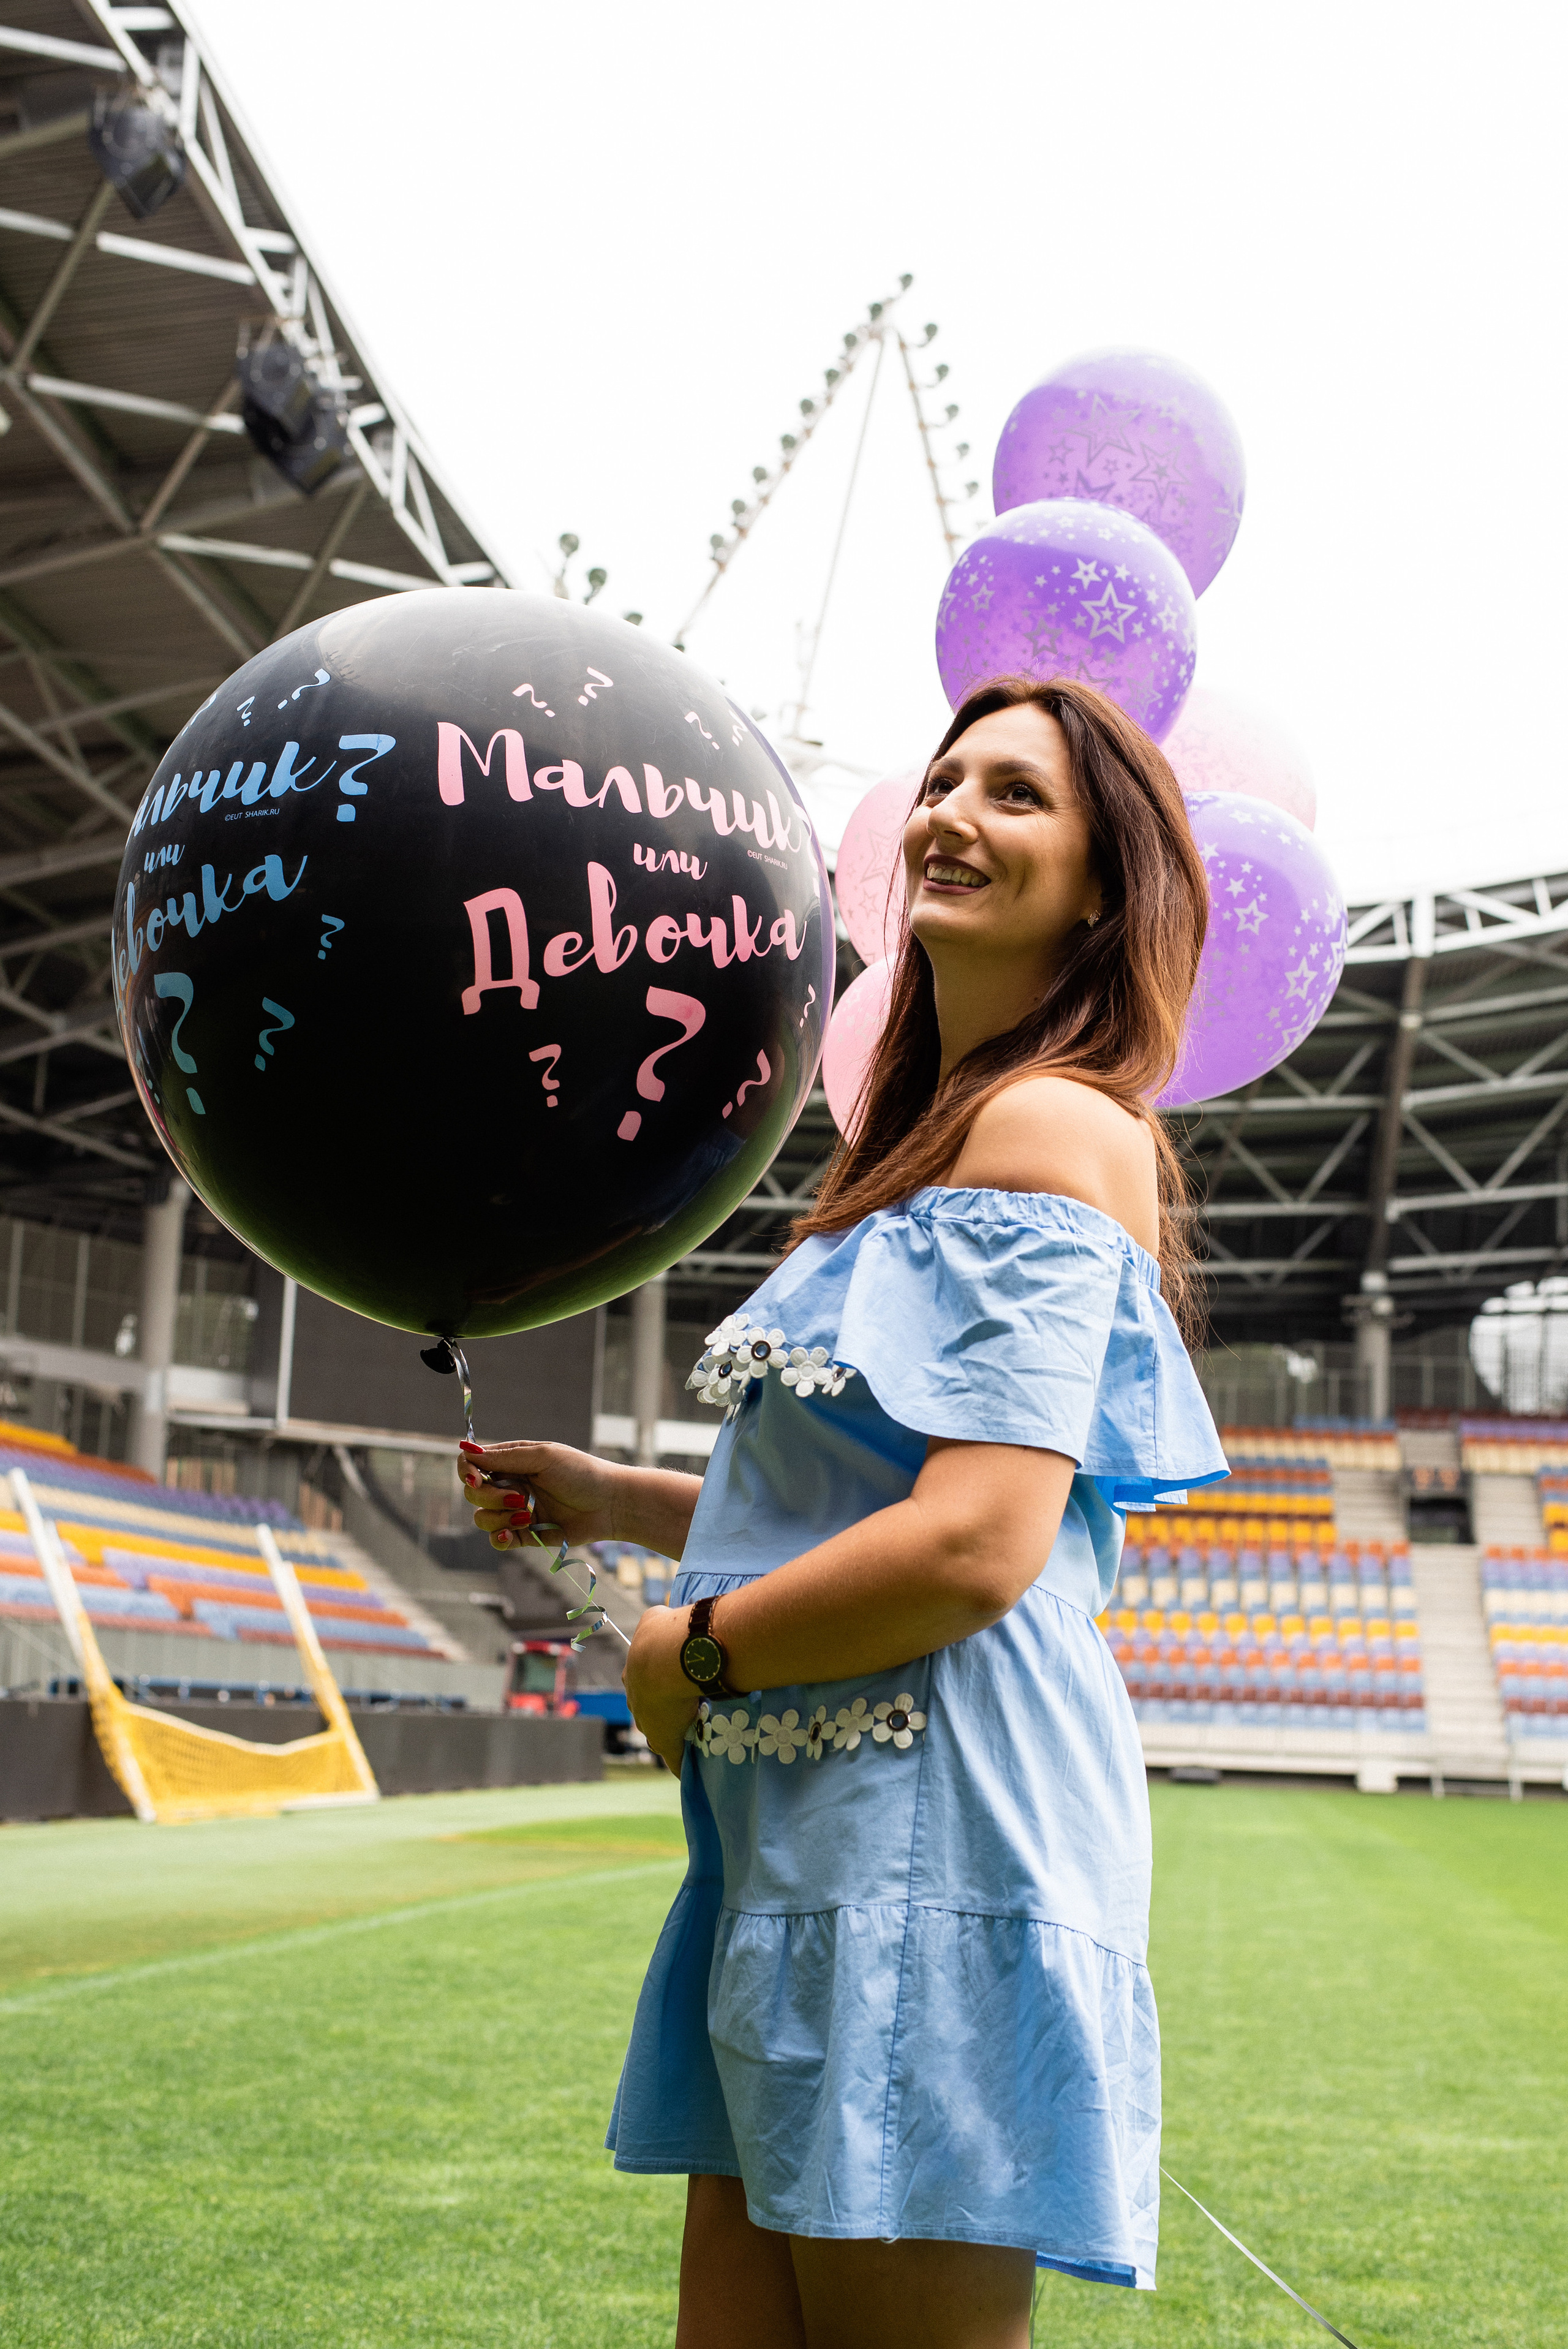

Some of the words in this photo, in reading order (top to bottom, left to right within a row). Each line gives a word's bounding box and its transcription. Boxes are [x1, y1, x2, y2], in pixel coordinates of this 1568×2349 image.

[244, 808, 280, 818] SHARIK.RU
[144, 844, 186, 874] или
[633, 842, 707, 880] или
[461, 861, 807, 1016] Девочка
[617, 985, 706, 1142] ?
